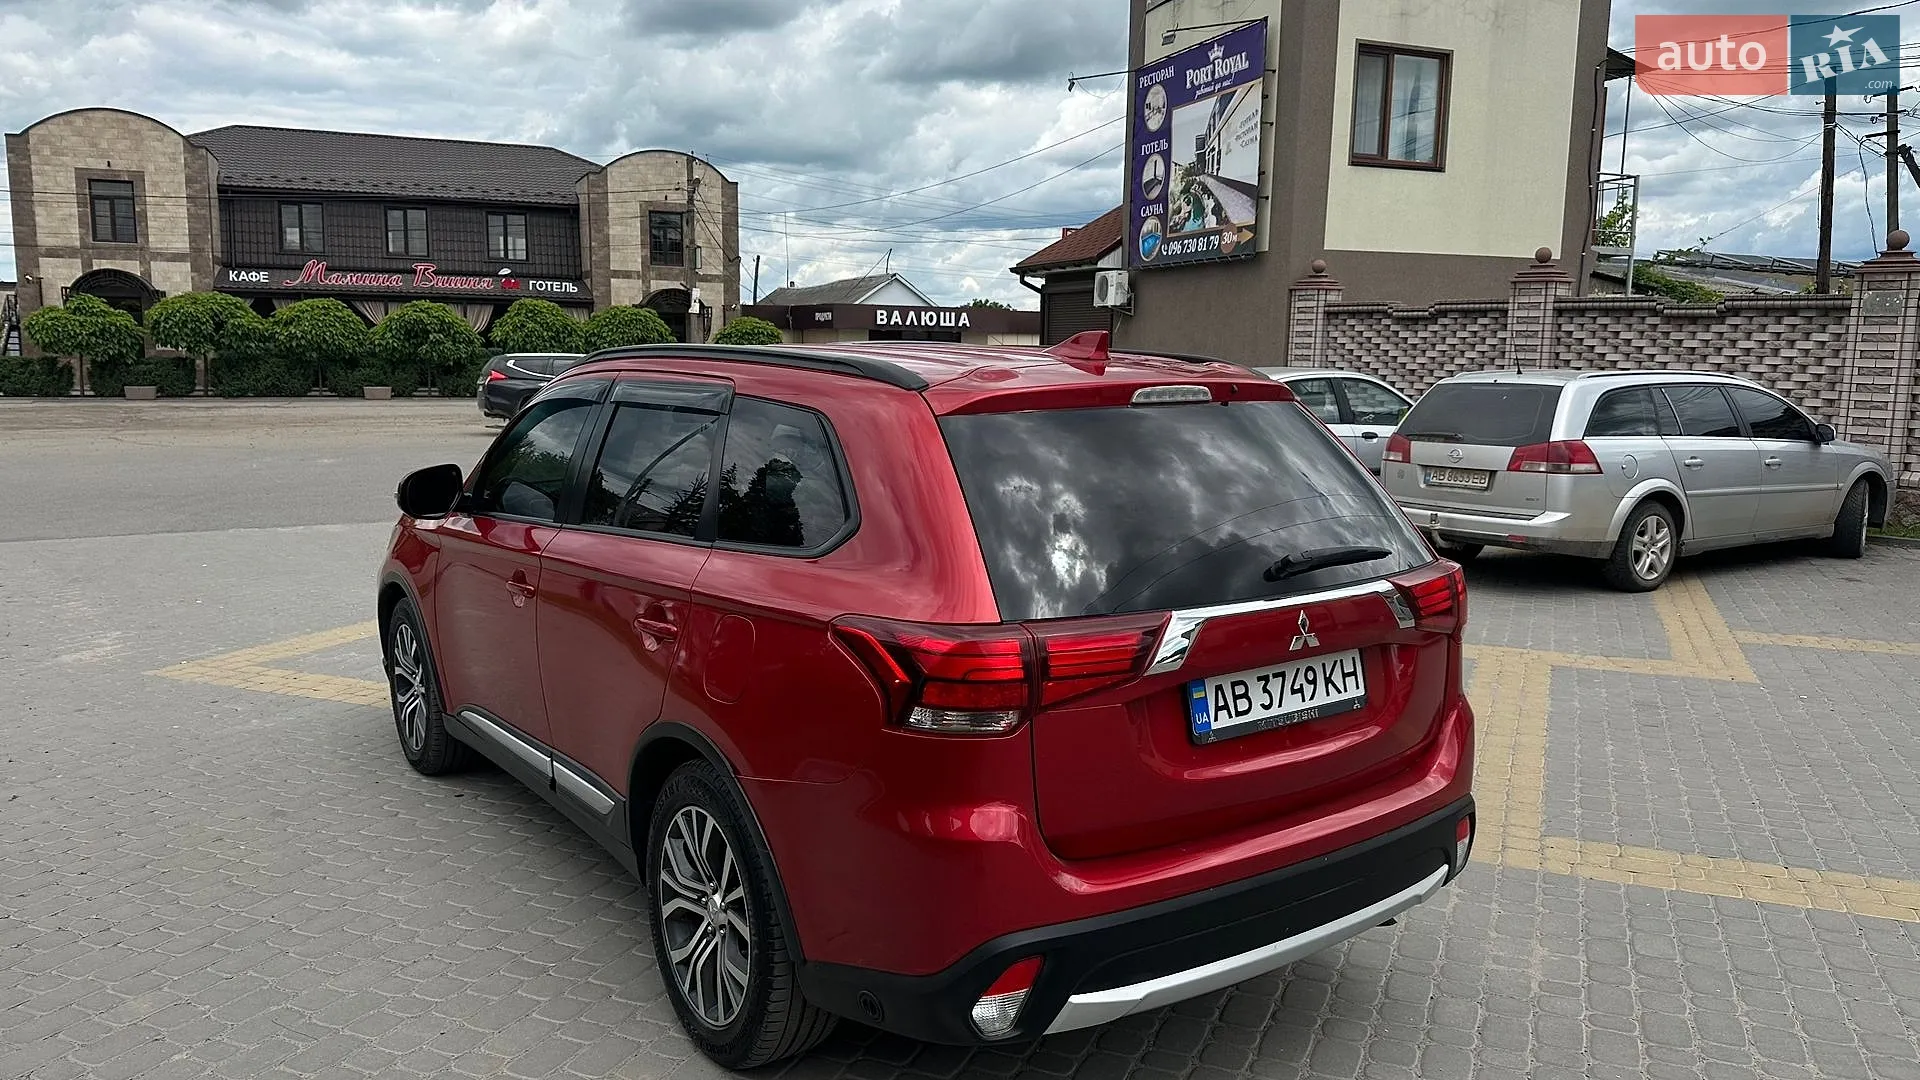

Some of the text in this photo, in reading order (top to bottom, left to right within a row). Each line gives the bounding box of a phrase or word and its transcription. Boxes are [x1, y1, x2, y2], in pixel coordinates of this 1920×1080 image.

[1139, 65, 1175, 88] РЕСТОРАН
[1186, 52, 1249, 89] PORT ROYAL
[1141, 139, 1168, 156] ГОТЕЛЬ
[1140, 203, 1163, 217] САУНА
[1168, 235, 1220, 255] 096 730 81 79
[229, 259, 578, 293] КАФЕ Мамина Вишня ГОТЕЛЬ
[876, 309, 970, 328] ВАЛЮША
[1214, 656, 1360, 722] AB 3749 KH
[1196, 713, 1210, 724] UA
